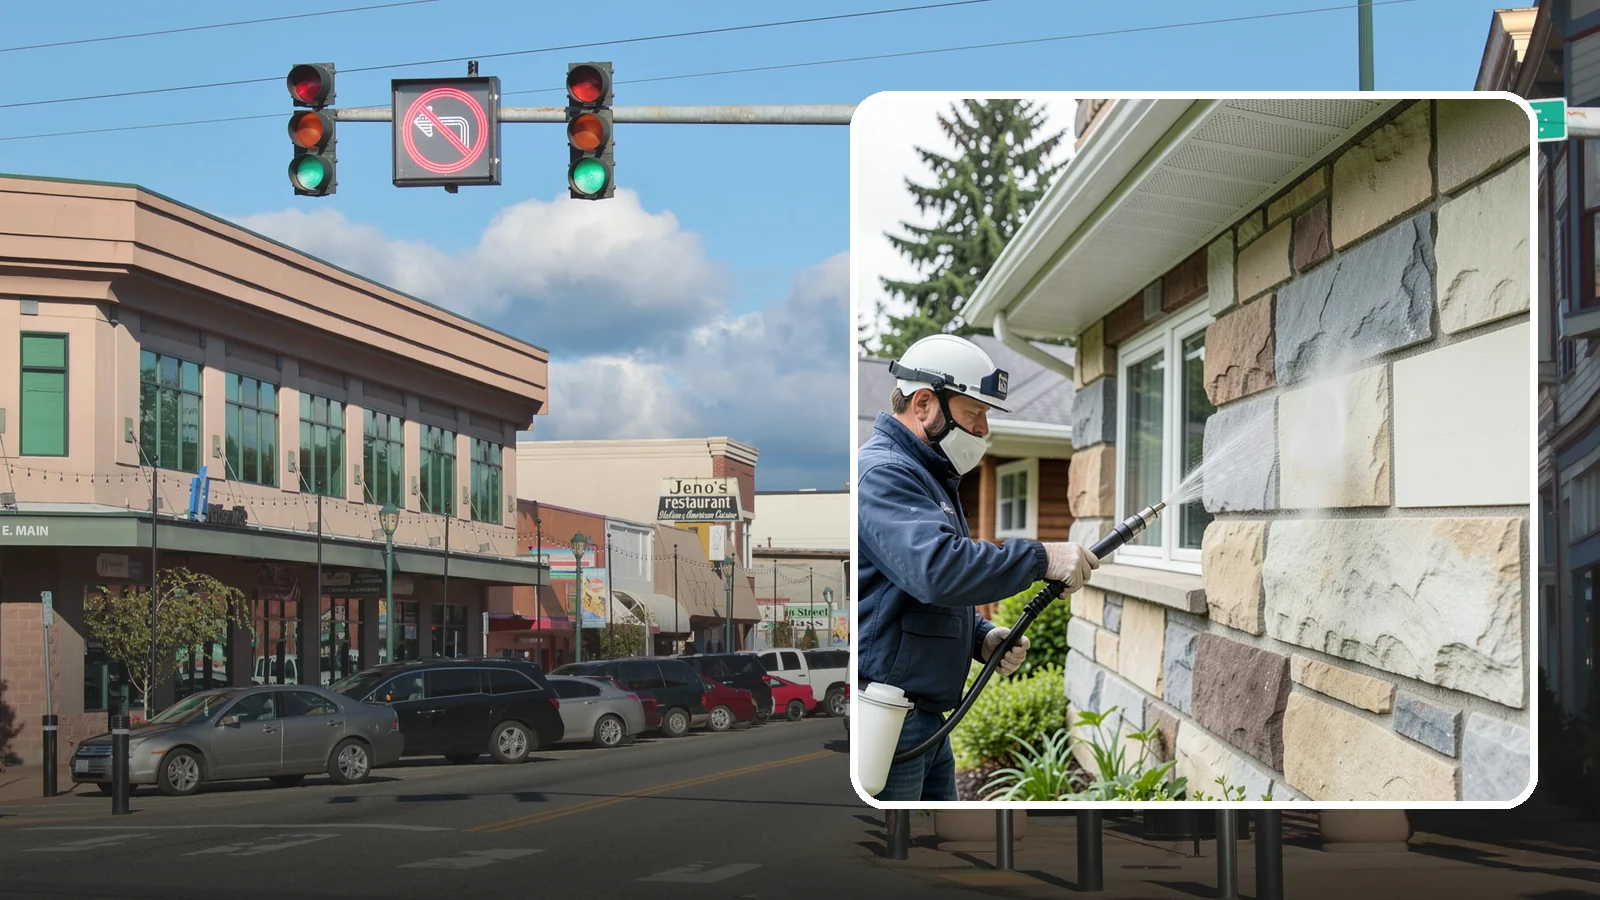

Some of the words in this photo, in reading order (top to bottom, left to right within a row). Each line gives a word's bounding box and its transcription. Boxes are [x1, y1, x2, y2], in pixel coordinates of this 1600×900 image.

[669, 480, 727, 494] Jeno's
[665, 496, 730, 509] restaurant
[659, 510, 681, 519] Italian
[686, 510, 714, 519] American
[715, 510, 737, 519] Cuisine
[2, 525, 13, 536] E.
[15, 525, 49, 536] MAIN
[797, 607, 828, 616] Street
[790, 619, 823, 627] lass
